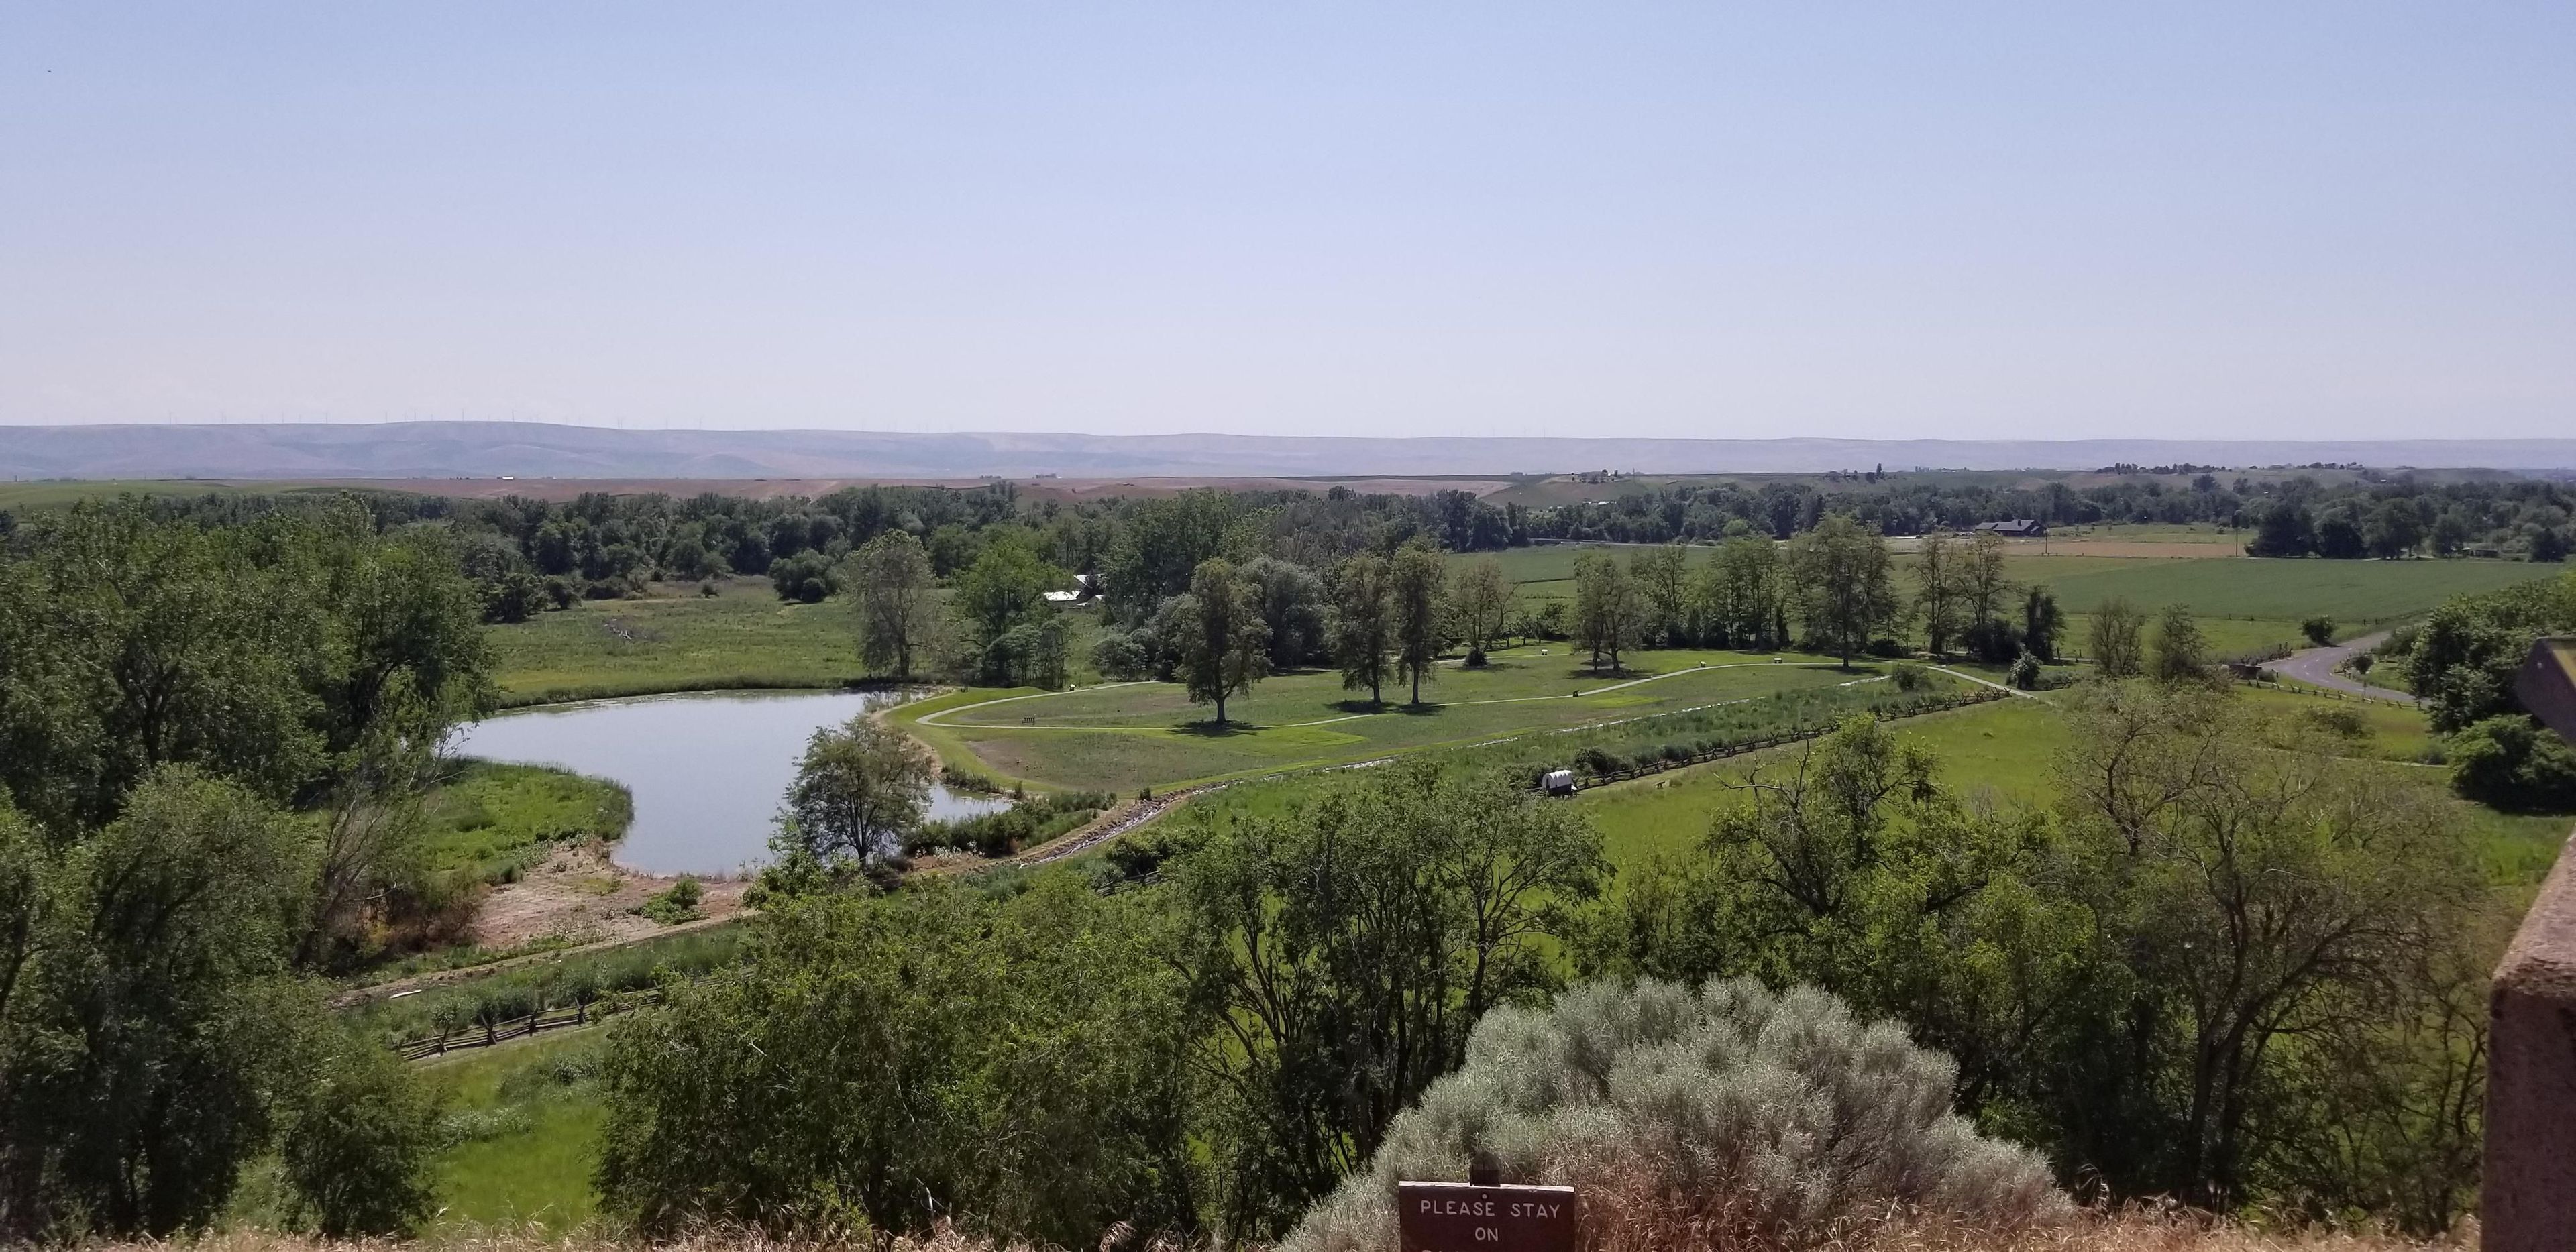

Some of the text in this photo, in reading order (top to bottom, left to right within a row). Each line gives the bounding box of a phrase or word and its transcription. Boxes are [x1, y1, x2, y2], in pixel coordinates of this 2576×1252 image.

[1421, 1200, 1560, 1218] PLEASE STAY
[1474, 1227, 1499, 1242] ON
